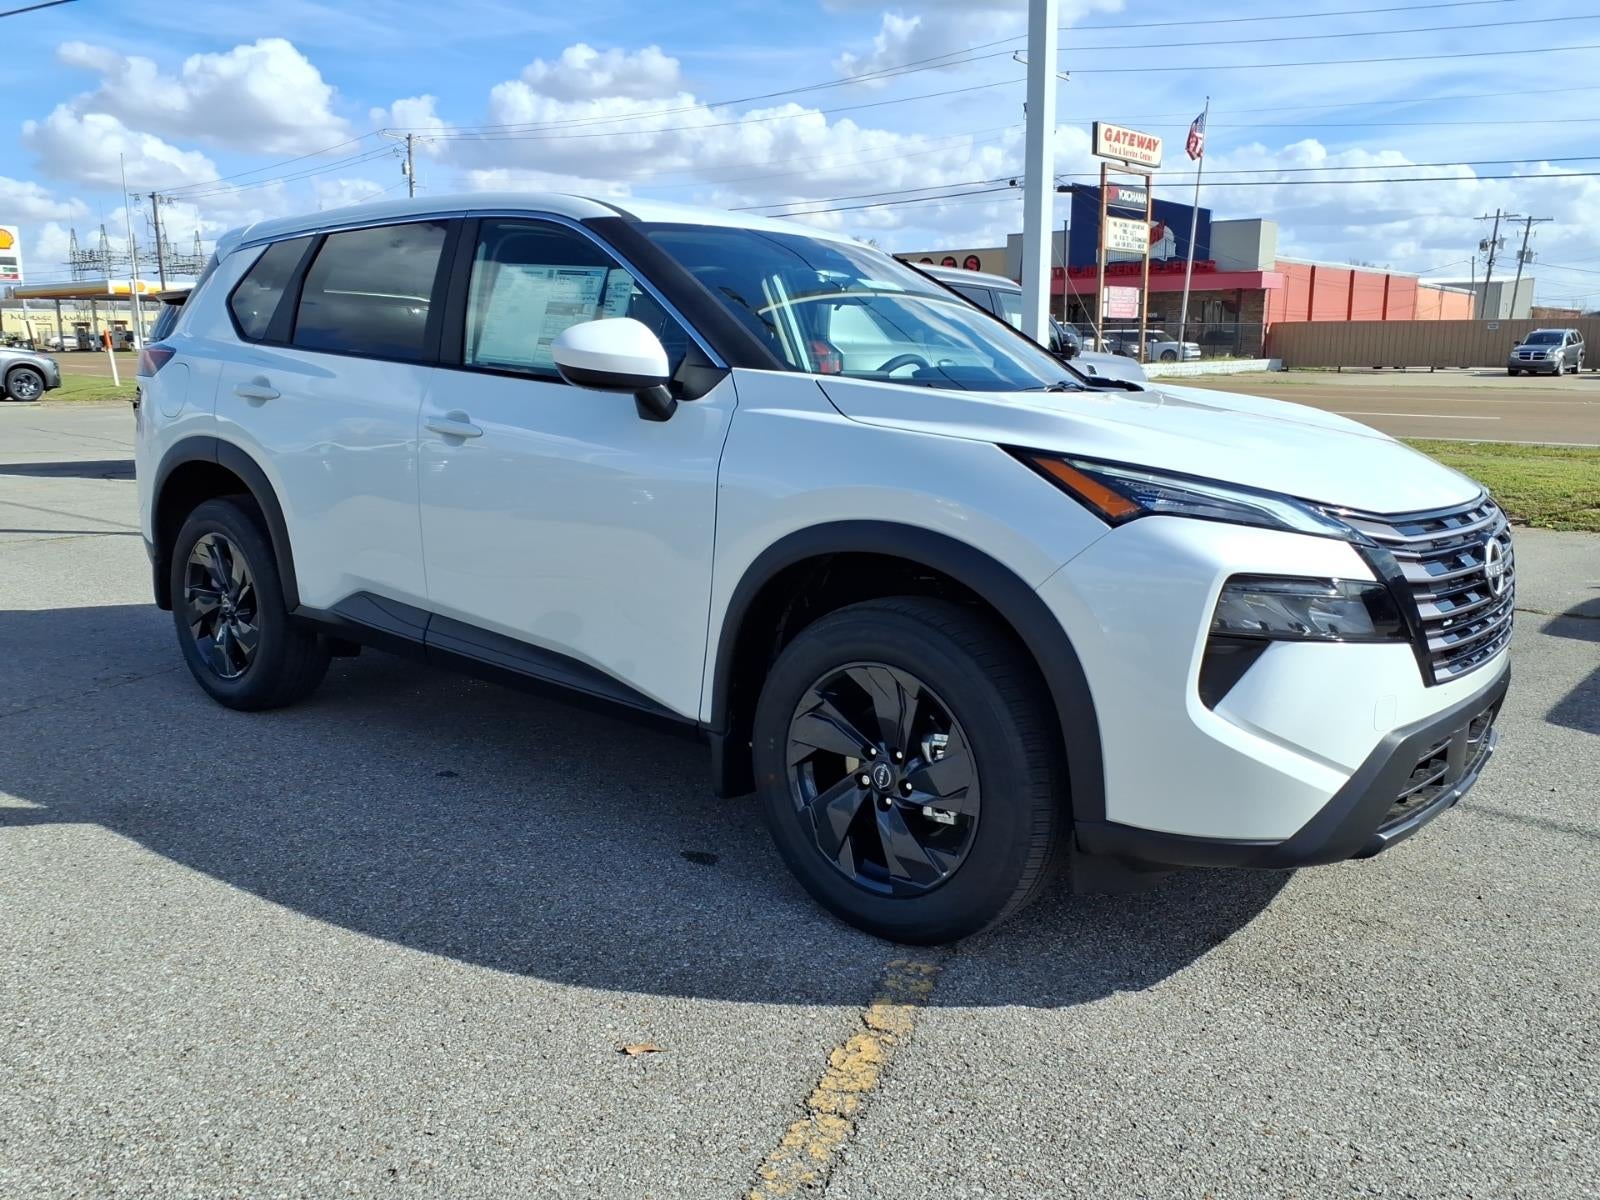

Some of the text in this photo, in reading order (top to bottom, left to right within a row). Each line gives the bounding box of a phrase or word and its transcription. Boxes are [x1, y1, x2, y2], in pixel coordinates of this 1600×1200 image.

[1104, 127, 1160, 152] GATEWAY
[1123, 147, 1138, 159] Service
[1118, 189, 1147, 204] YOKOHAMA
[1109, 262, 1162, 276] SERVE
[1165, 259, 1217, 273] CENER
[1485, 564, 1504, 577] NISS
